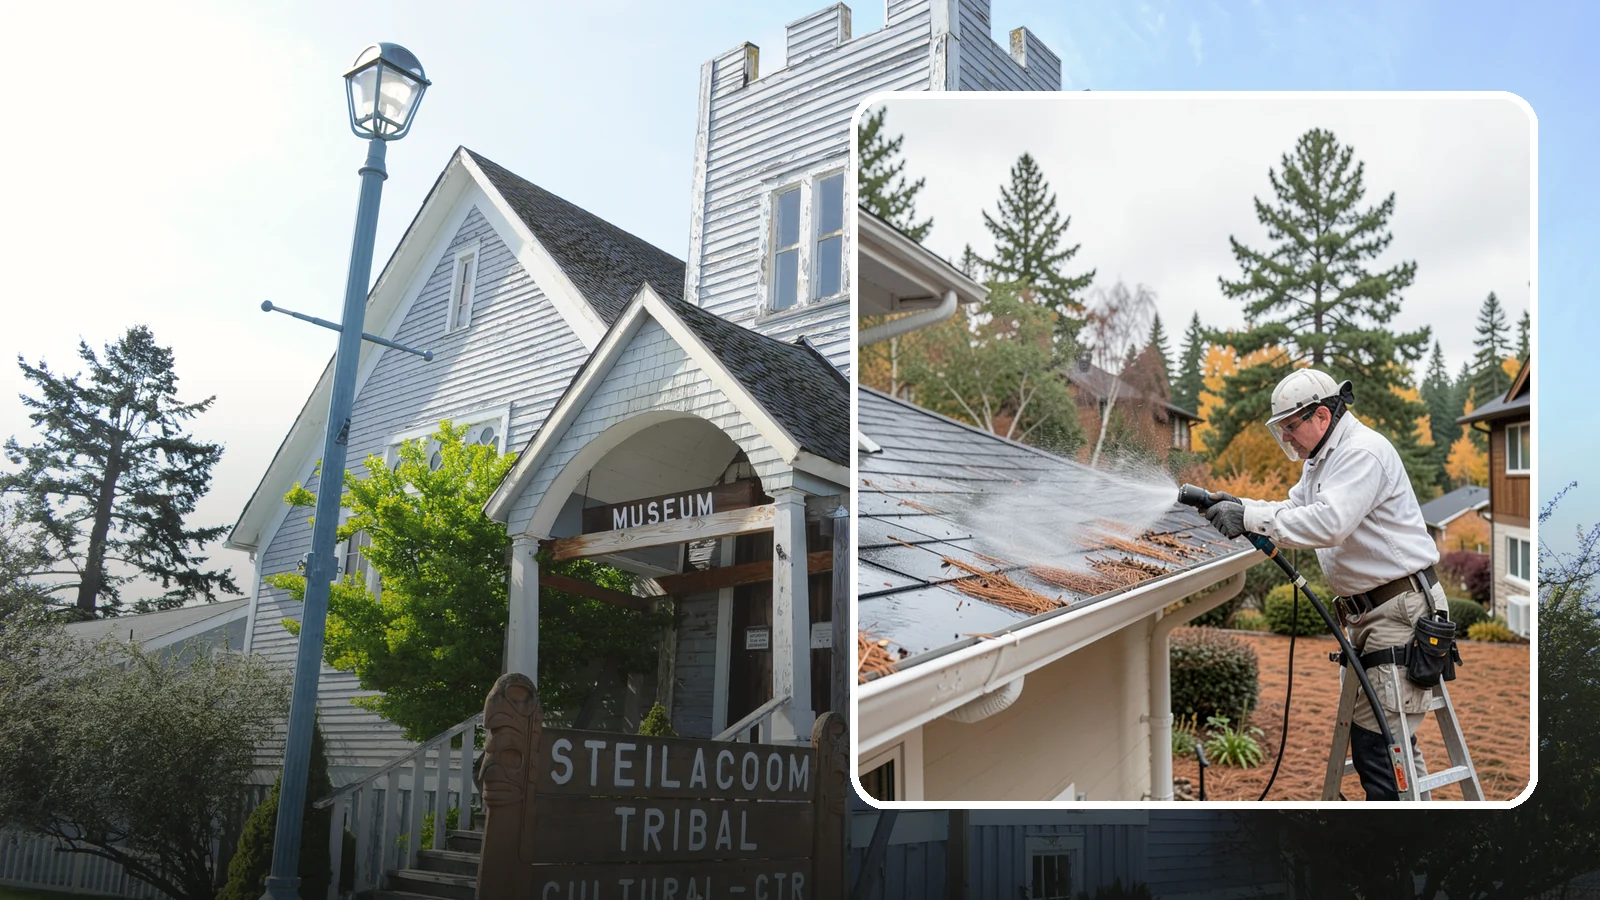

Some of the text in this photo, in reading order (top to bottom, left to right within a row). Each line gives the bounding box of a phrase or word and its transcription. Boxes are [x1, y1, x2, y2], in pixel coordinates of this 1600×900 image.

[612, 491, 714, 531] MUSEUM
[550, 738, 810, 792] STEILACOOM
[614, 806, 757, 851] TRIBAL
